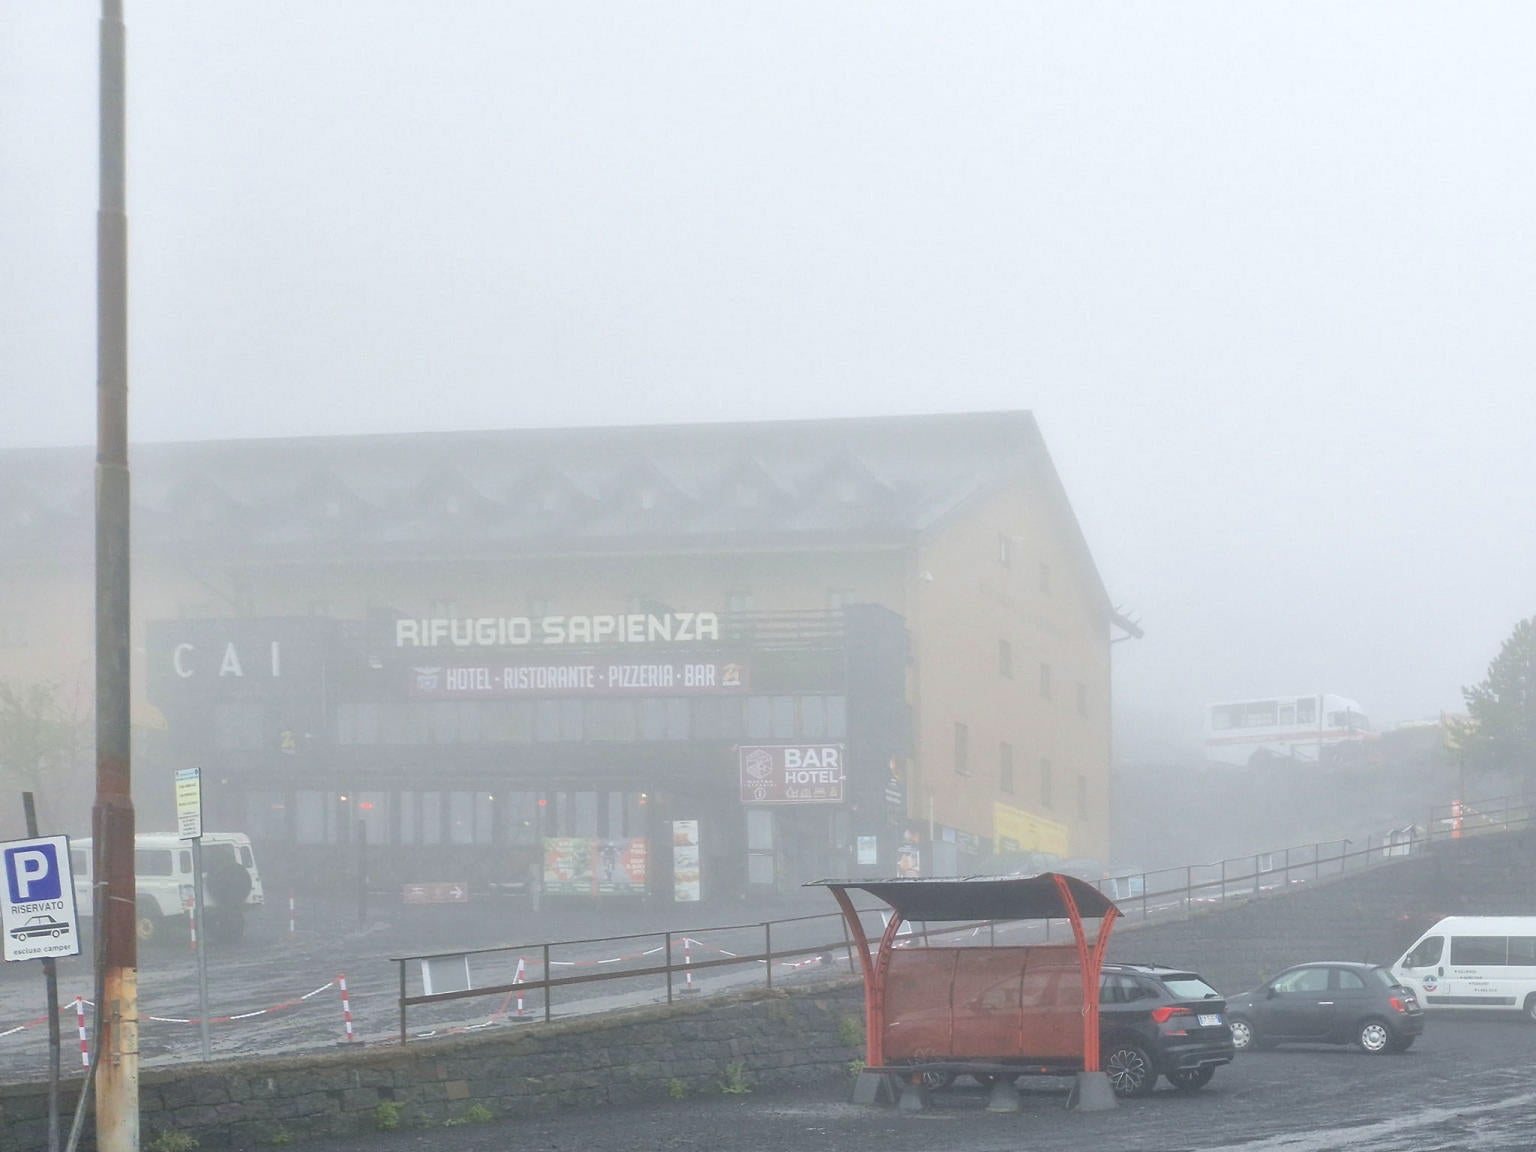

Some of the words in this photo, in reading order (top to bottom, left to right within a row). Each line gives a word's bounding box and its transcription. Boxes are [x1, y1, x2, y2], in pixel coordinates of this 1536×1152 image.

[397, 617, 532, 647] RIFUGIO
[542, 611, 719, 645] SAPIENZA
[446, 667, 493, 691] HOTEL
[503, 665, 596, 689] RISTORANTE
[608, 664, 674, 688] PIZZERIA
[684, 663, 716, 687] BAR
[784, 748, 839, 768] BAR
[784, 770, 839, 784] HOTEL
[13, 850, 49, 899] P
[11, 900, 65, 915] RISERVATO
[44, 943, 72, 955] camper
